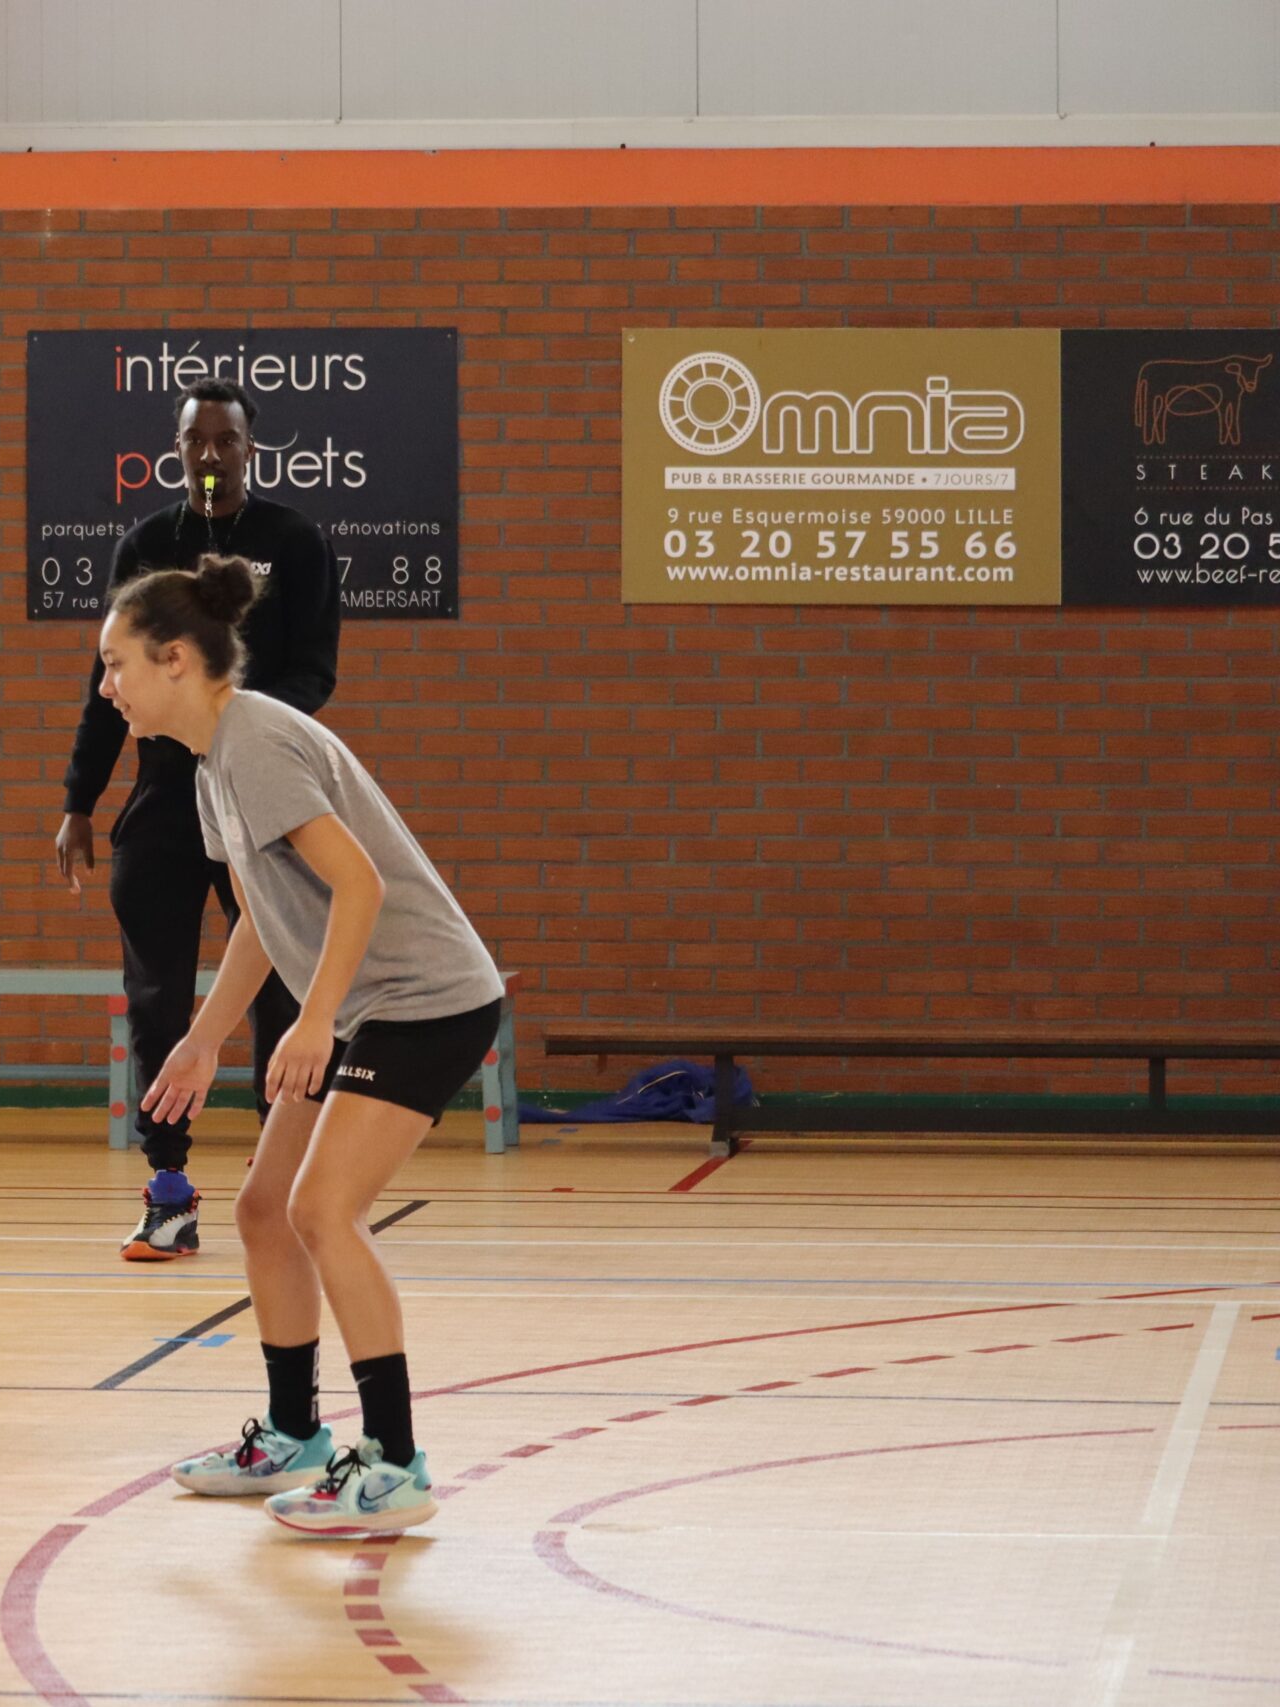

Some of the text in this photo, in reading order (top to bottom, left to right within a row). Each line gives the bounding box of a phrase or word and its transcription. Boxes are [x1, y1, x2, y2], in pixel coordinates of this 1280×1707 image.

[115, 341, 367, 391] intérieurs
[658, 351, 1025, 456] Omnia
[114, 430, 368, 504] pauets
[671, 473, 702, 484] PUB
[707, 473, 717, 485] &
[723, 473, 806, 485] BRASSERIE
[811, 473, 916, 485] GOURMANDE
[667, 507, 1014, 528] 9 rue Esquermoise 59000 LILLE
[1134, 506, 1273, 525] 6 rue du Pas
[42, 520, 441, 541] parquets rénovations
[663, 530, 1017, 559] 03 20 57 55 66
[1133, 532, 1182, 560] 03
[1199, 532, 1250, 560] 20
[336, 557, 352, 584] 7
[666, 562, 1014, 581] www.omnia-restaurant.com
[1136, 561, 1280, 584] www.beef-re
[43, 590, 441, 609] 57 rue AMBERSART
